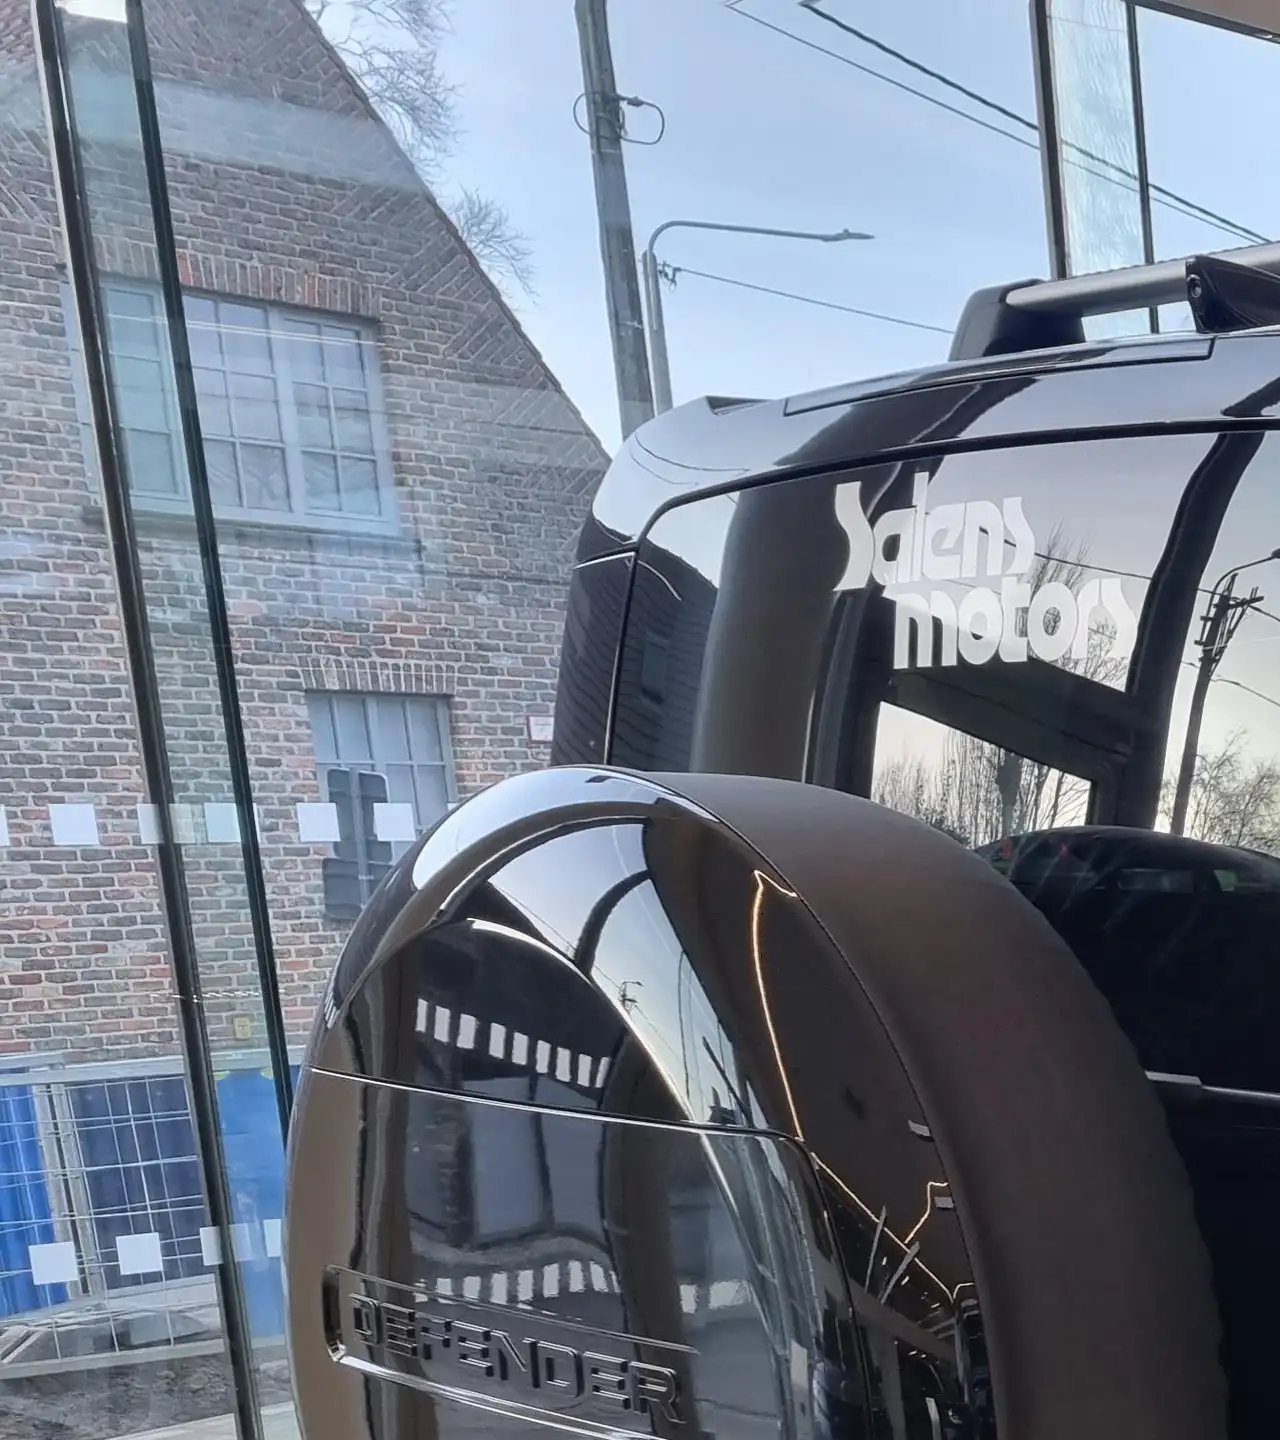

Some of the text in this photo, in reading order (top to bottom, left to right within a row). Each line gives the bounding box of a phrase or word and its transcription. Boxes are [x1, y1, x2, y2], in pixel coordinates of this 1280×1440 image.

[833, 471, 1035, 591] Salens
[883, 576, 1138, 669] motors
[347, 1291, 687, 1425] DEFENDER
